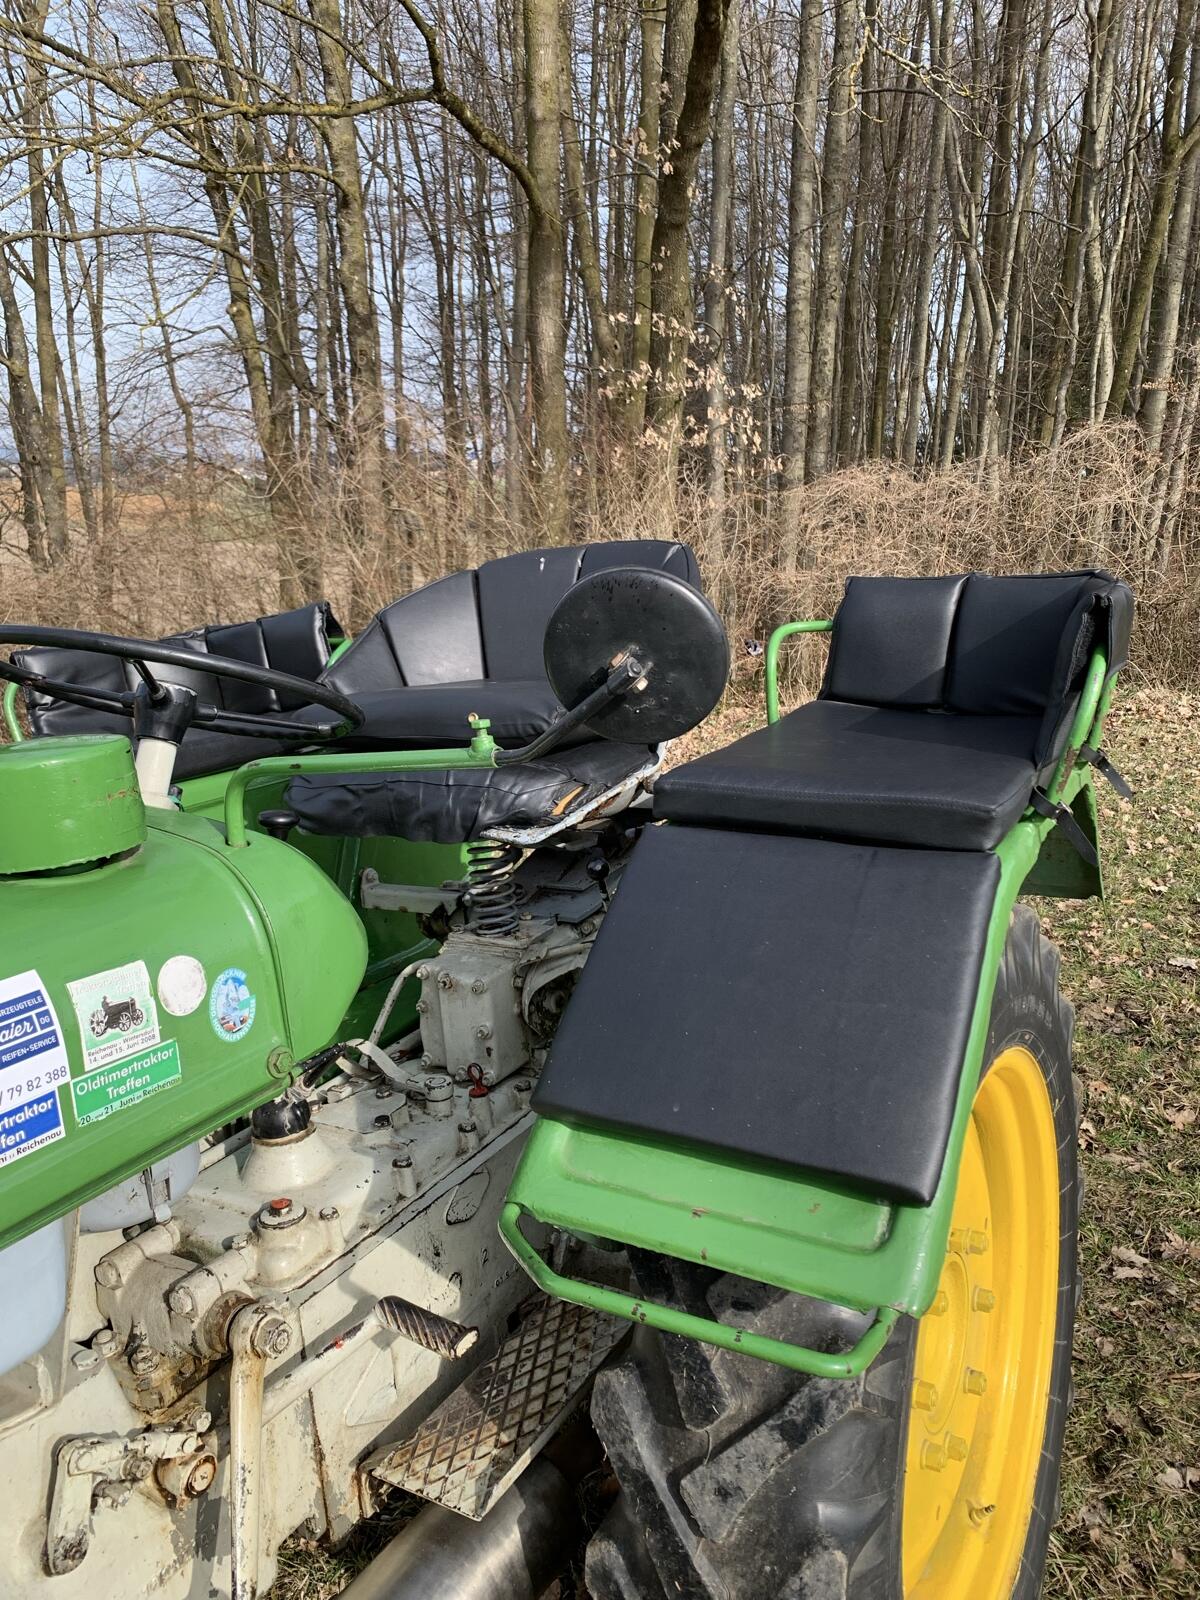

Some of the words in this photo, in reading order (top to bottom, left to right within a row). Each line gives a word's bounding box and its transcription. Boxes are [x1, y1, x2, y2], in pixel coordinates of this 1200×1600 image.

[0, 995, 44, 1016] RZEUGTEILE
[88, 1042, 118, 1057] Reichenau
[100, 1051, 113, 1060] und
[126, 1041, 139, 1050] Juni
[141, 1034, 155, 1044] 2008
[7, 1084, 22, 1101] 79
[26, 1076, 42, 1092] 82
[44, 1065, 67, 1084] 388
[76, 1048, 174, 1095] Oldtimertraktor
[106, 1074, 150, 1099] Treffen
[80, 1115, 94, 1125] 20.
[119, 1095, 136, 1108] Juni
[16, 1130, 62, 1156] Reichenau
